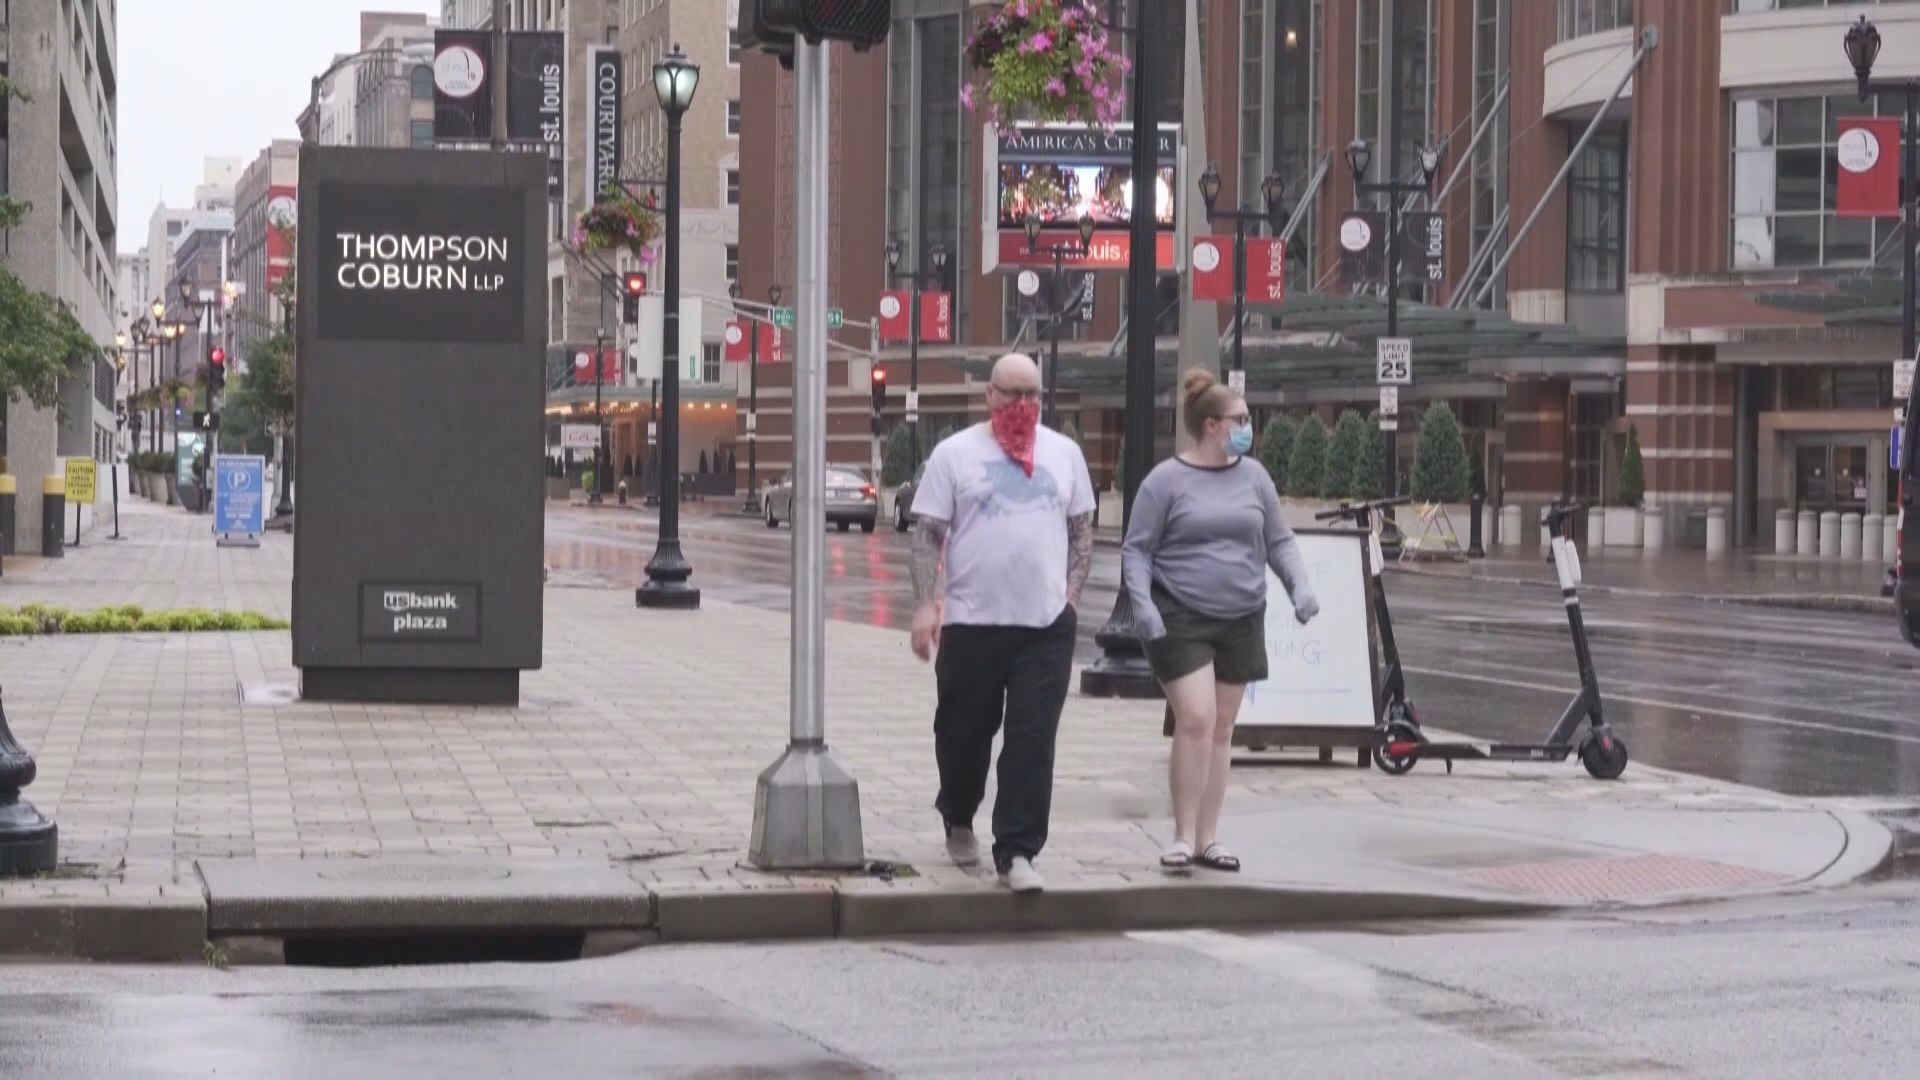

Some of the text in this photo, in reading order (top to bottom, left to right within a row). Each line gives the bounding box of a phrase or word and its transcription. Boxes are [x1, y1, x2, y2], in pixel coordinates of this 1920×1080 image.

[539, 64, 560, 142] st. louis
[1005, 135, 1169, 150] AMERICA'S CENR
[336, 232, 508, 262] THOMPSON
[1425, 216, 1442, 280] st. louis
[337, 262, 504, 291] COBURN LLP
[1267, 241, 1282, 300] st. louis
[1081, 272, 1095, 303] louis
[937, 295, 948, 322] louis
[1381, 343, 1409, 352] SPEED
[1383, 352, 1404, 360] LIMIT
[1381, 361, 1408, 379] 25
[394, 612, 446, 632] plaza
